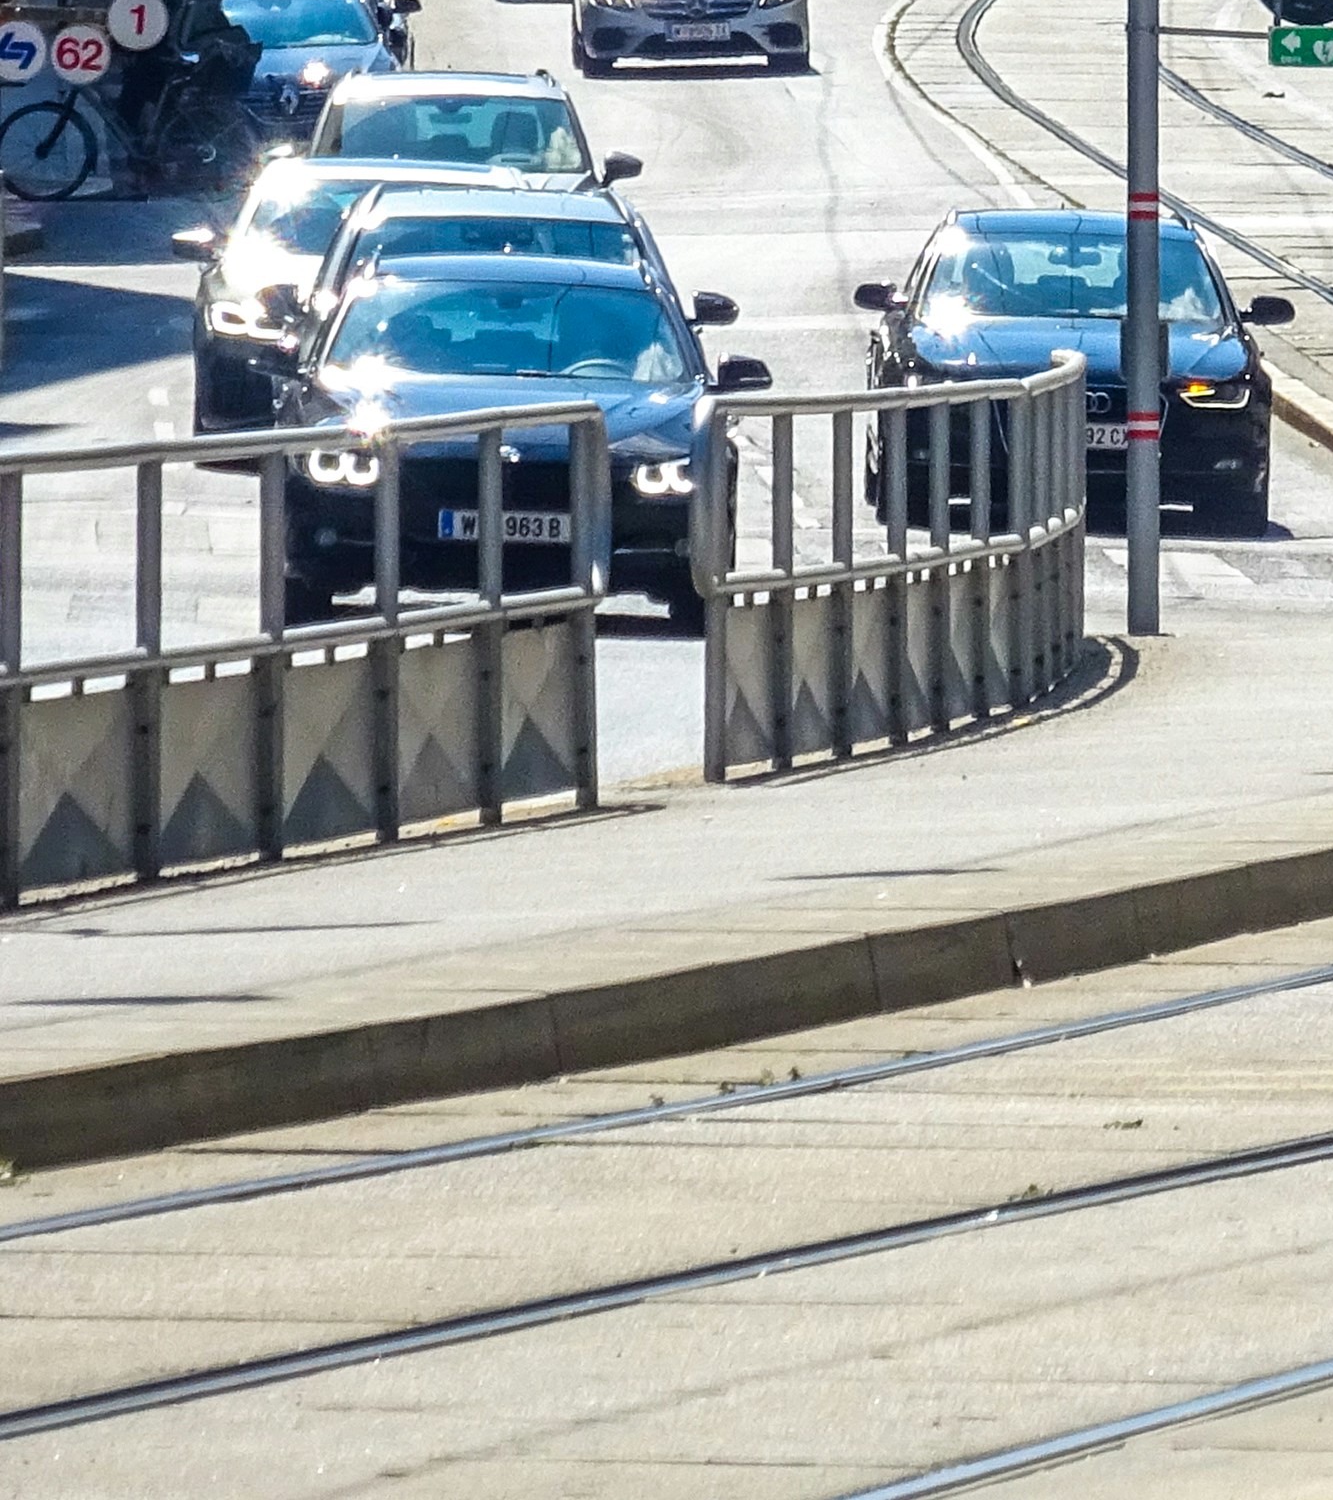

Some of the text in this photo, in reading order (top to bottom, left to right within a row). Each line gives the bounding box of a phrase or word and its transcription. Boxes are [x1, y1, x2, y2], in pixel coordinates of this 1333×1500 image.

[130, 3, 146, 35] 1
[55, 38, 103, 71] 62
[461, 514, 475, 535] W
